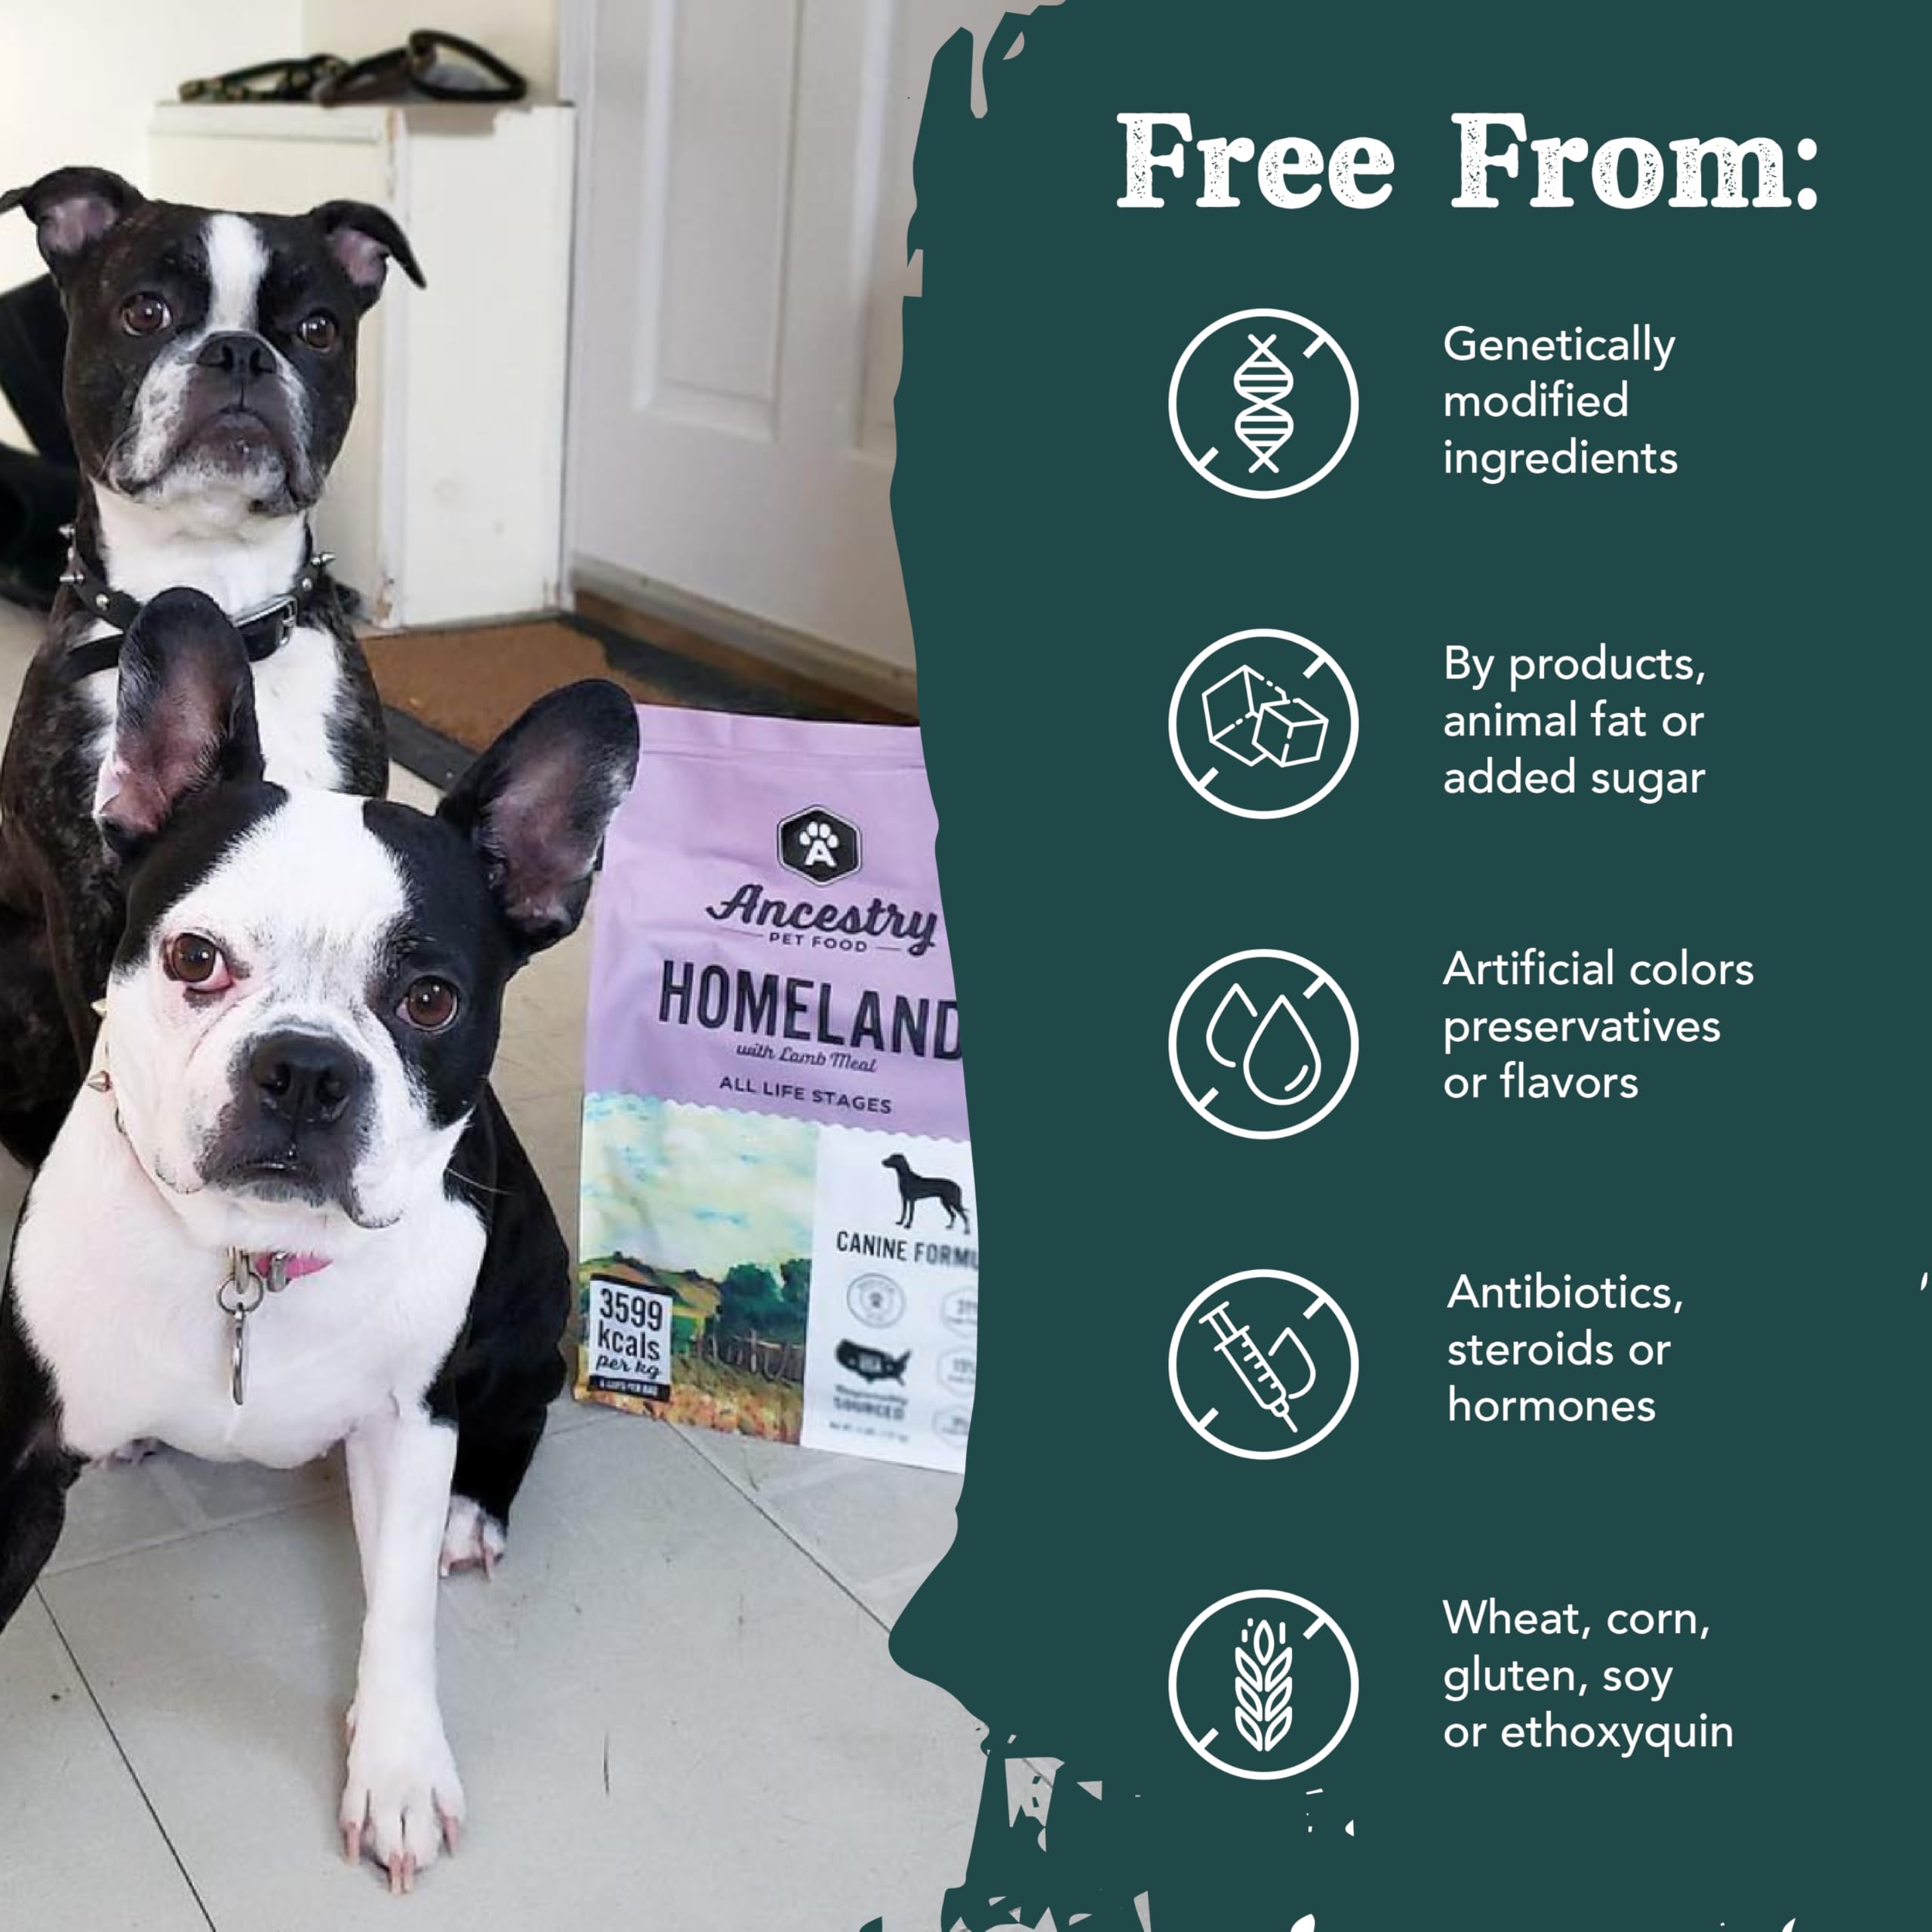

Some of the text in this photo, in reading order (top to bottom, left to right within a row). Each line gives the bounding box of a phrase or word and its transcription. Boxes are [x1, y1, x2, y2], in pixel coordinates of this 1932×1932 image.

[705, 884, 937, 956] Ancestry
[769, 932, 867, 952] PET FOOD
[659, 960, 962, 1061] HOMELAND
[736, 1043, 878, 1073] with Lamb Meal
[719, 1075, 893, 1115] ALL LIFE STAGES
[836, 1231, 907, 1261] CANINE
[599, 1287, 663, 1331] 3599
[598, 1319, 660, 1361] kcals
[595, 1355, 663, 1380] per kg
